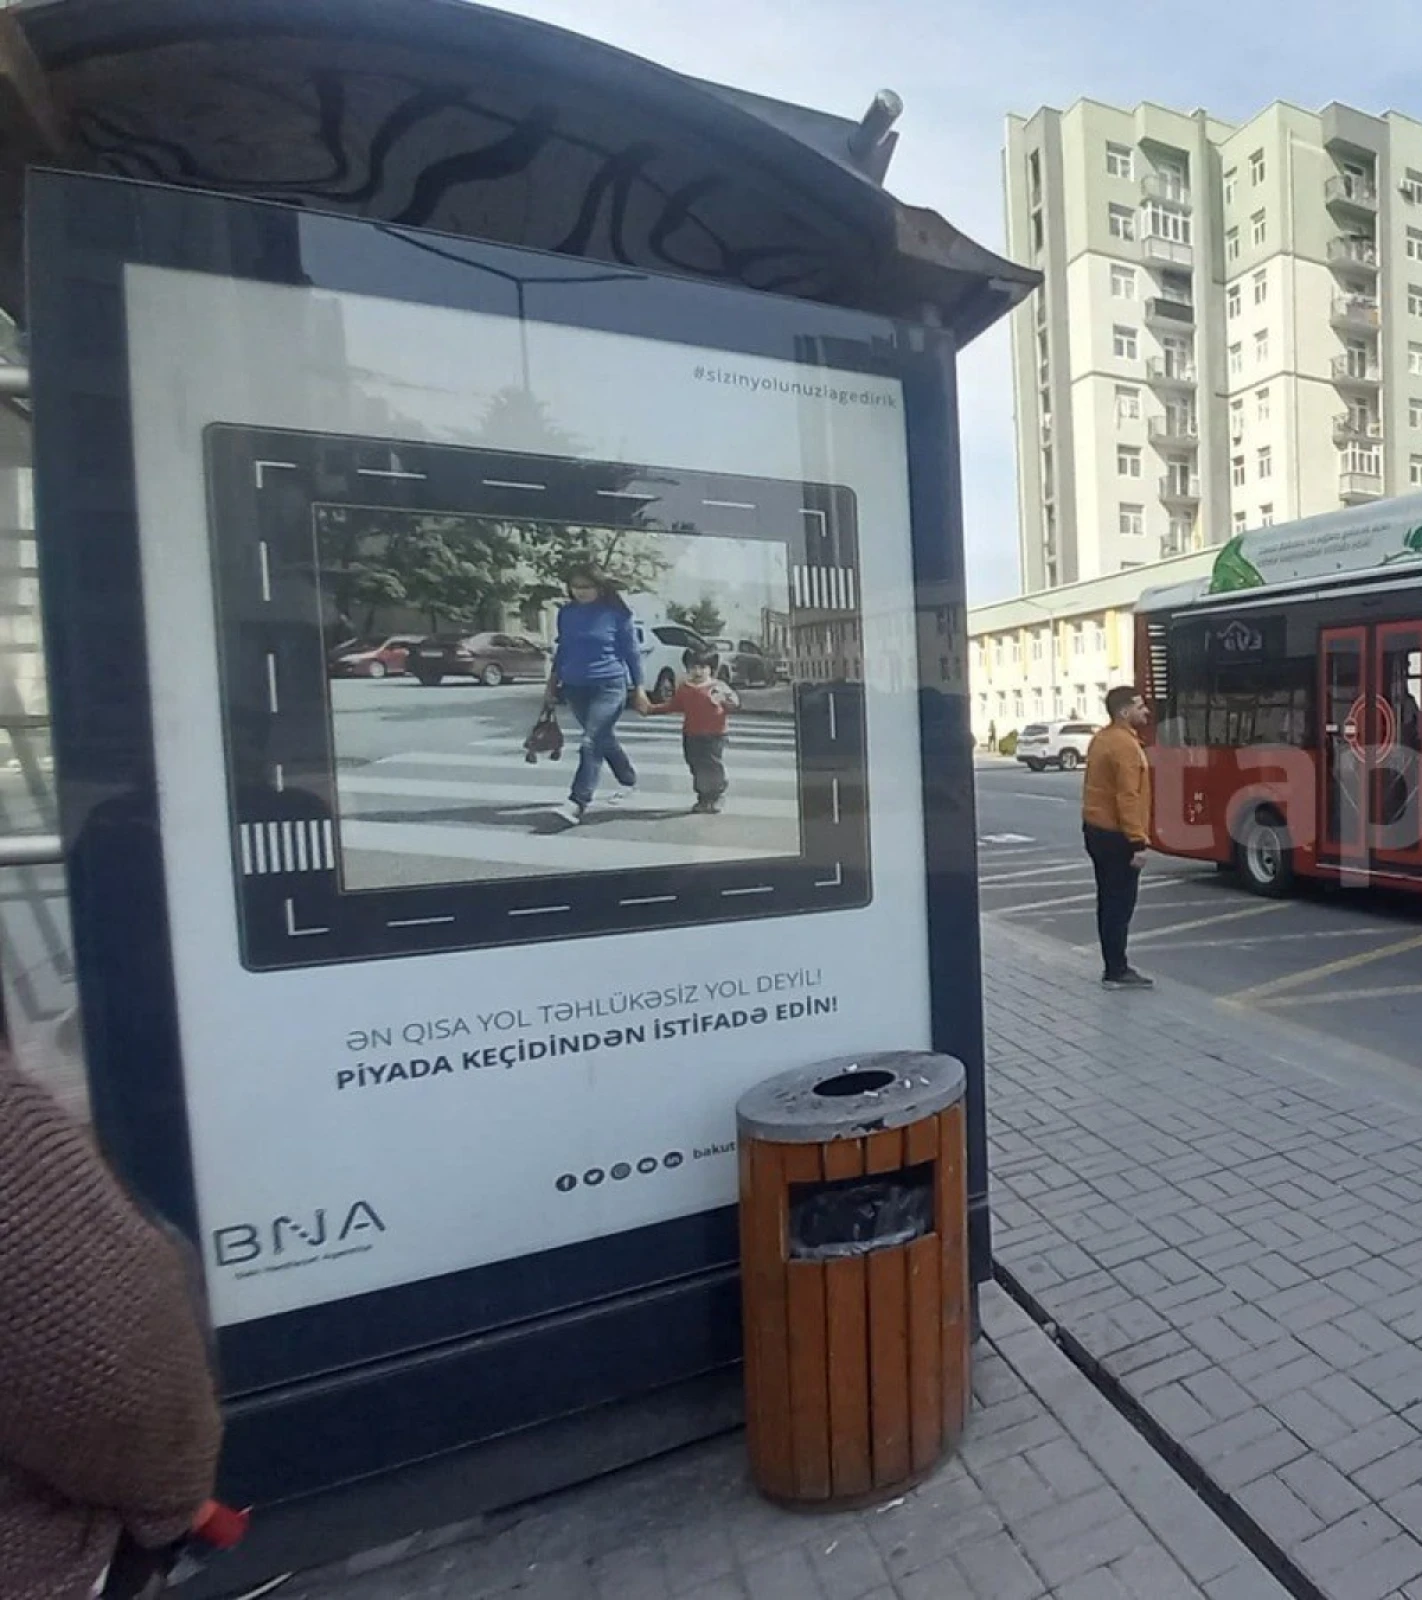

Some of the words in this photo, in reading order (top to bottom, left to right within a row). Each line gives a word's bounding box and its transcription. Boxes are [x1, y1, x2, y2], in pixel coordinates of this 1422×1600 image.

[337, 1055, 453, 1090] PİYADA
[462, 1024, 646, 1070] KEÇİDİNDƏN
[653, 1006, 768, 1041] İSTİFADƏ
[775, 995, 838, 1021] EDİN!
[346, 1027, 392, 1051] ƏN
[402, 1017, 471, 1046] QISA
[477, 1009, 531, 1032] YOL
[537, 984, 699, 1024] TƏHLÜKƏSİZ
[704, 978, 750, 1000] YOL
[756, 968, 822, 993] DEYİL!
[692, 1141, 737, 1160] bakut
[213, 1201, 386, 1266] BNA
